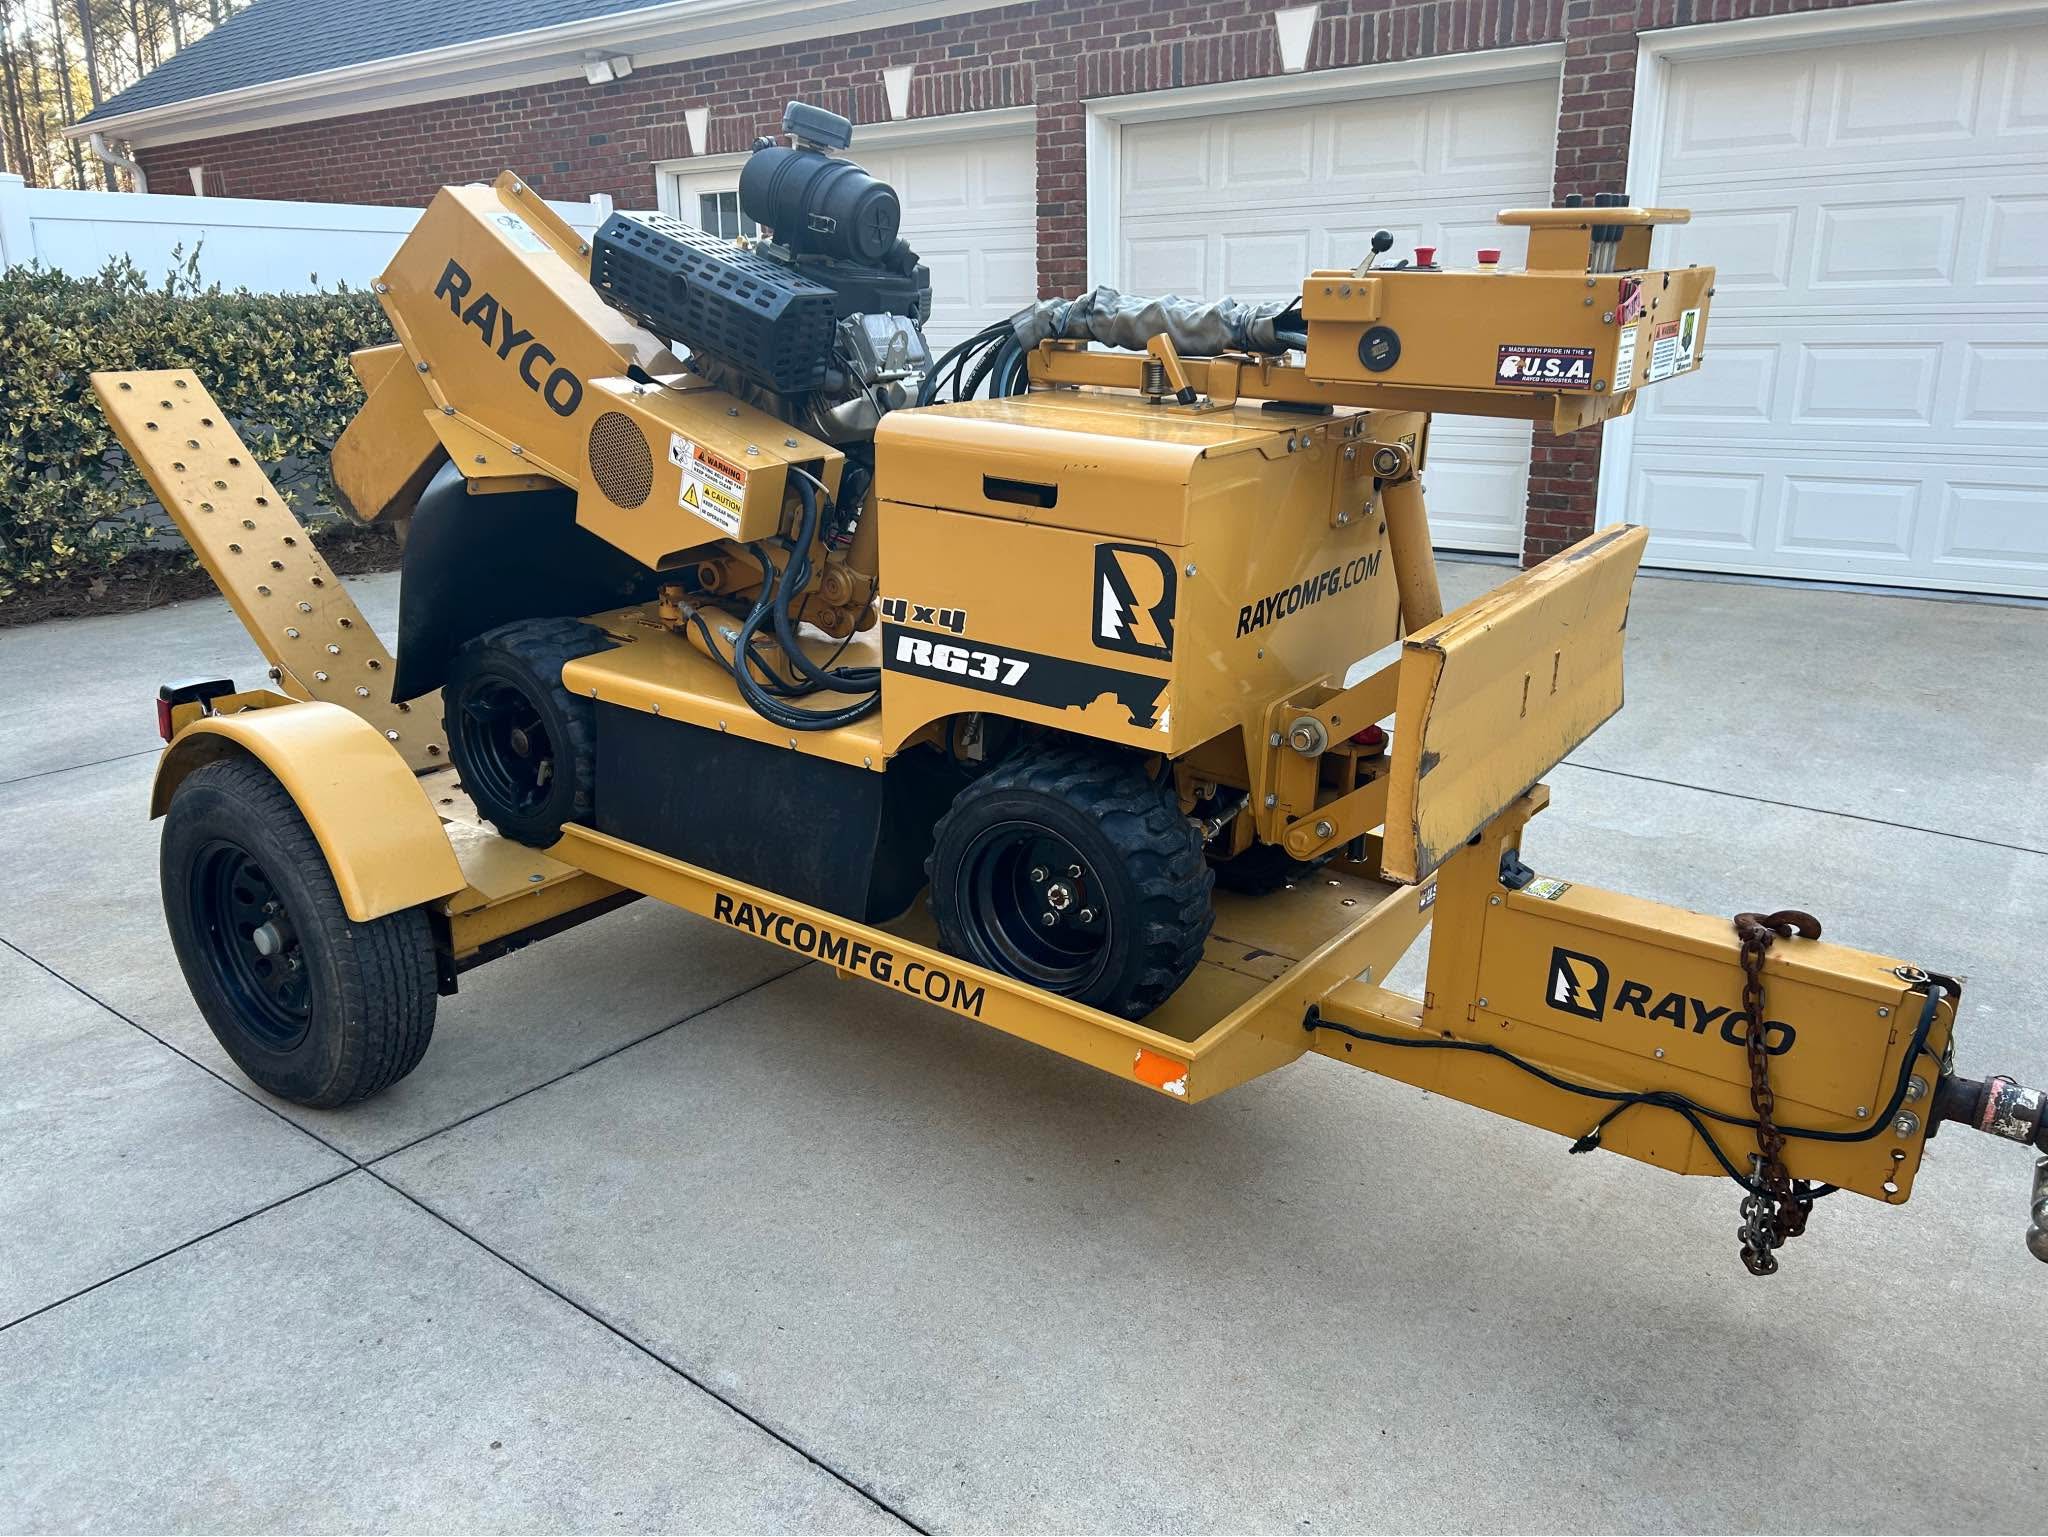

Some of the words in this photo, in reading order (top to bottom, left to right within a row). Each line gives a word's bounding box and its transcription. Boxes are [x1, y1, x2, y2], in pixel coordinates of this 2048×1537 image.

[434, 258, 583, 417] RAYCO
[1522, 357, 1590, 378] U.S.A.
[707, 456, 741, 481] WARNING
[703, 499, 713, 509] KEEP
[713, 504, 727, 516] CLEAR
[711, 491, 741, 512] CAUTION
[1236, 550, 1382, 638] RAYCOMFG.COM
[896, 635, 1030, 686] RG37
[713, 893, 985, 1016] RAYCOMFG.COM
[1613, 980, 1796, 1056] RAYCO
